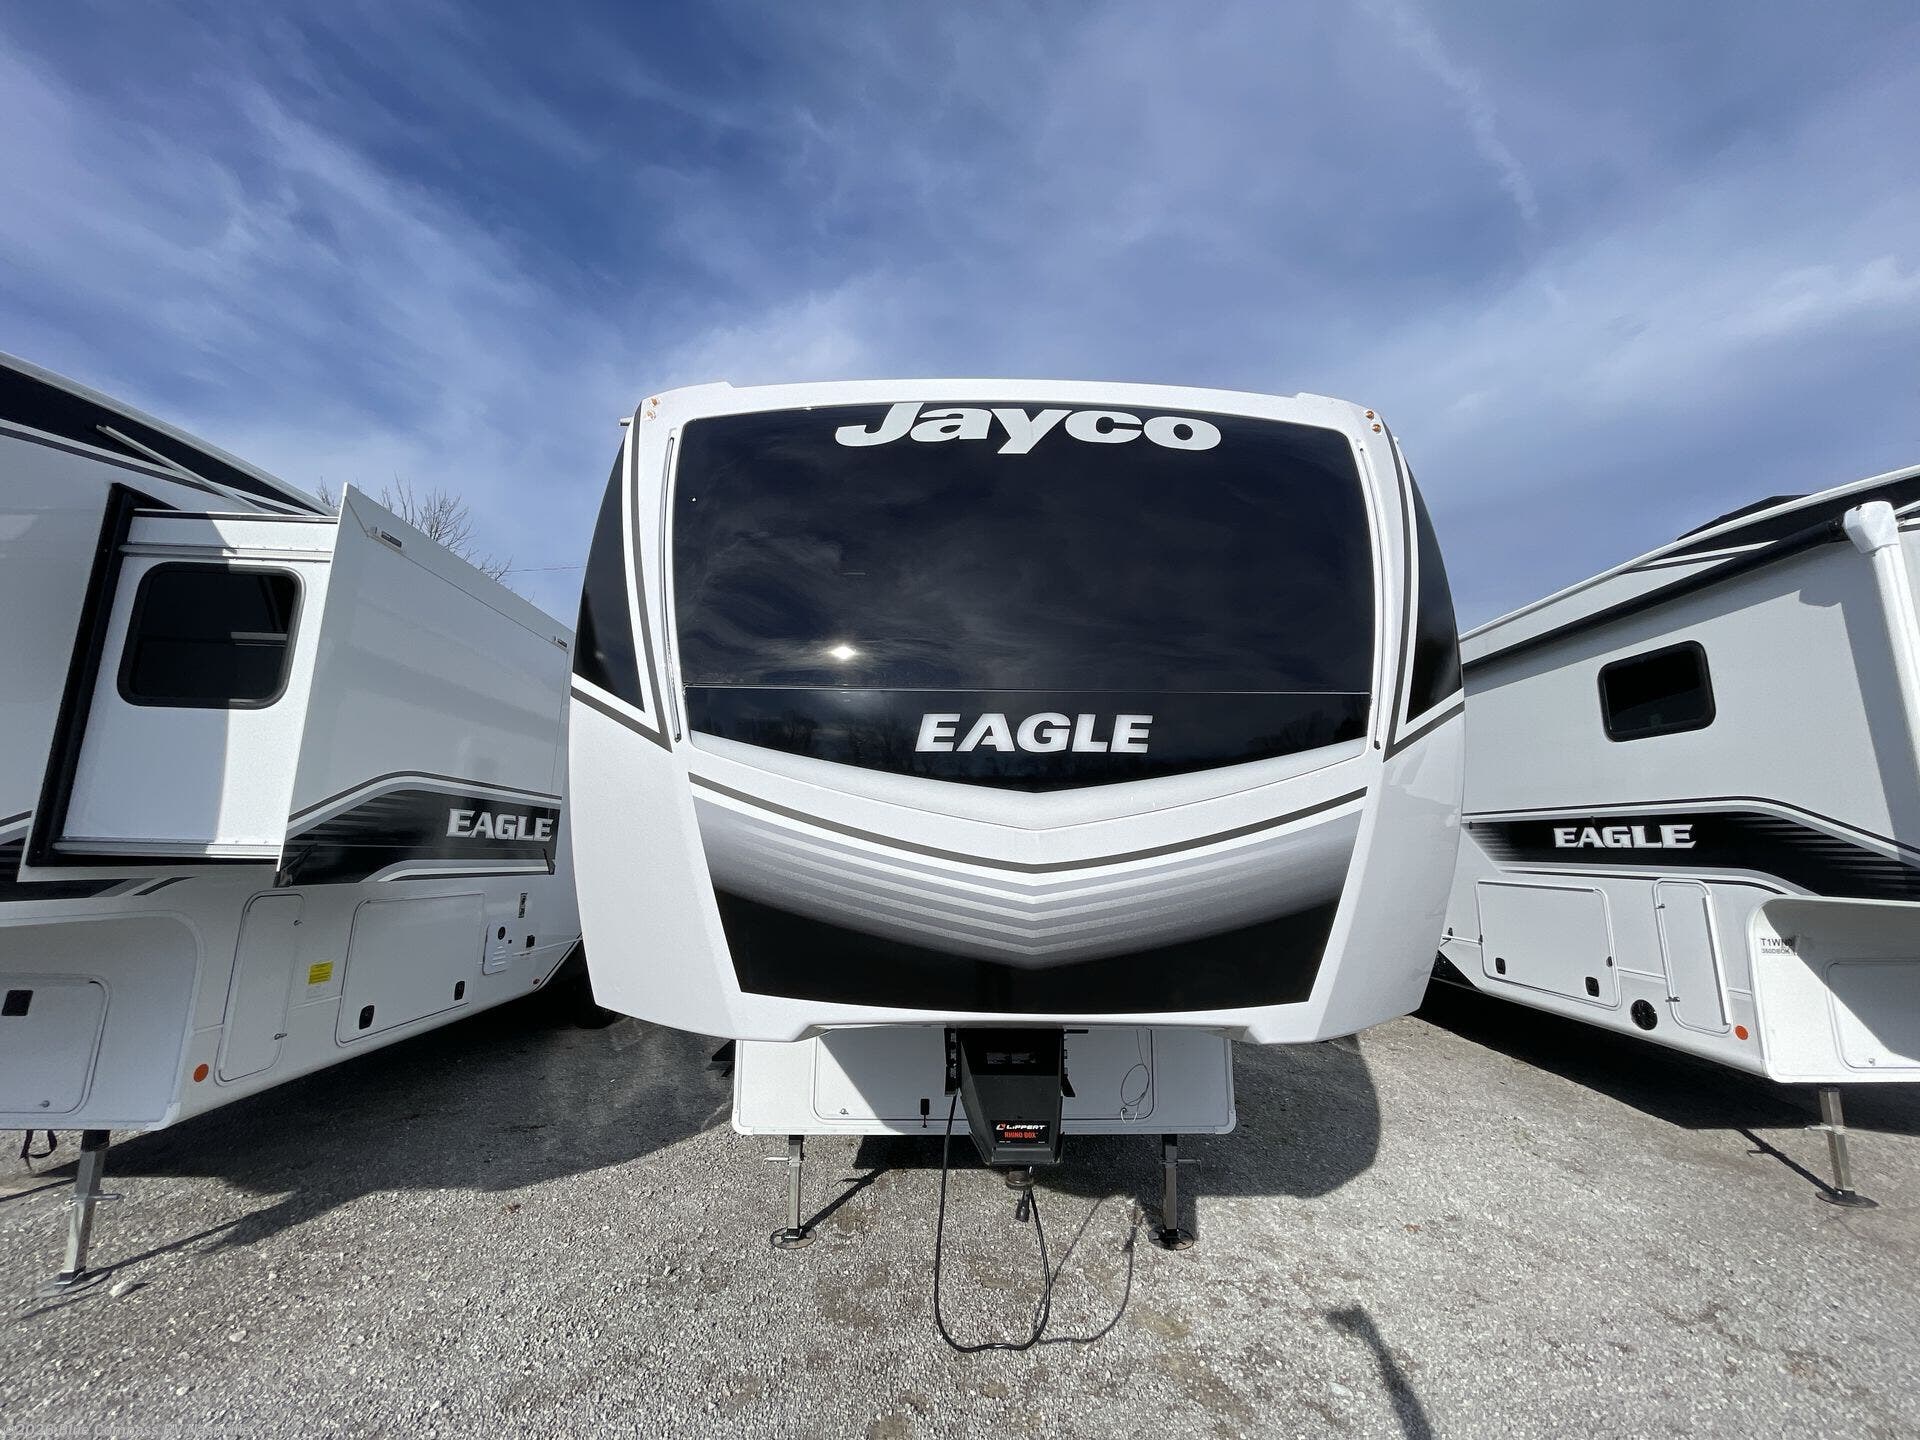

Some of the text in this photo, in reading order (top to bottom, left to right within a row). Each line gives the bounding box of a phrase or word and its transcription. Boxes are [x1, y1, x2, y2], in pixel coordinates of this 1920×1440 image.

[835, 402, 1222, 454] Jayco
[915, 712, 1153, 753] EAGLE
[446, 808, 554, 842] EAGLE
[1553, 824, 1697, 849] EAGLE
